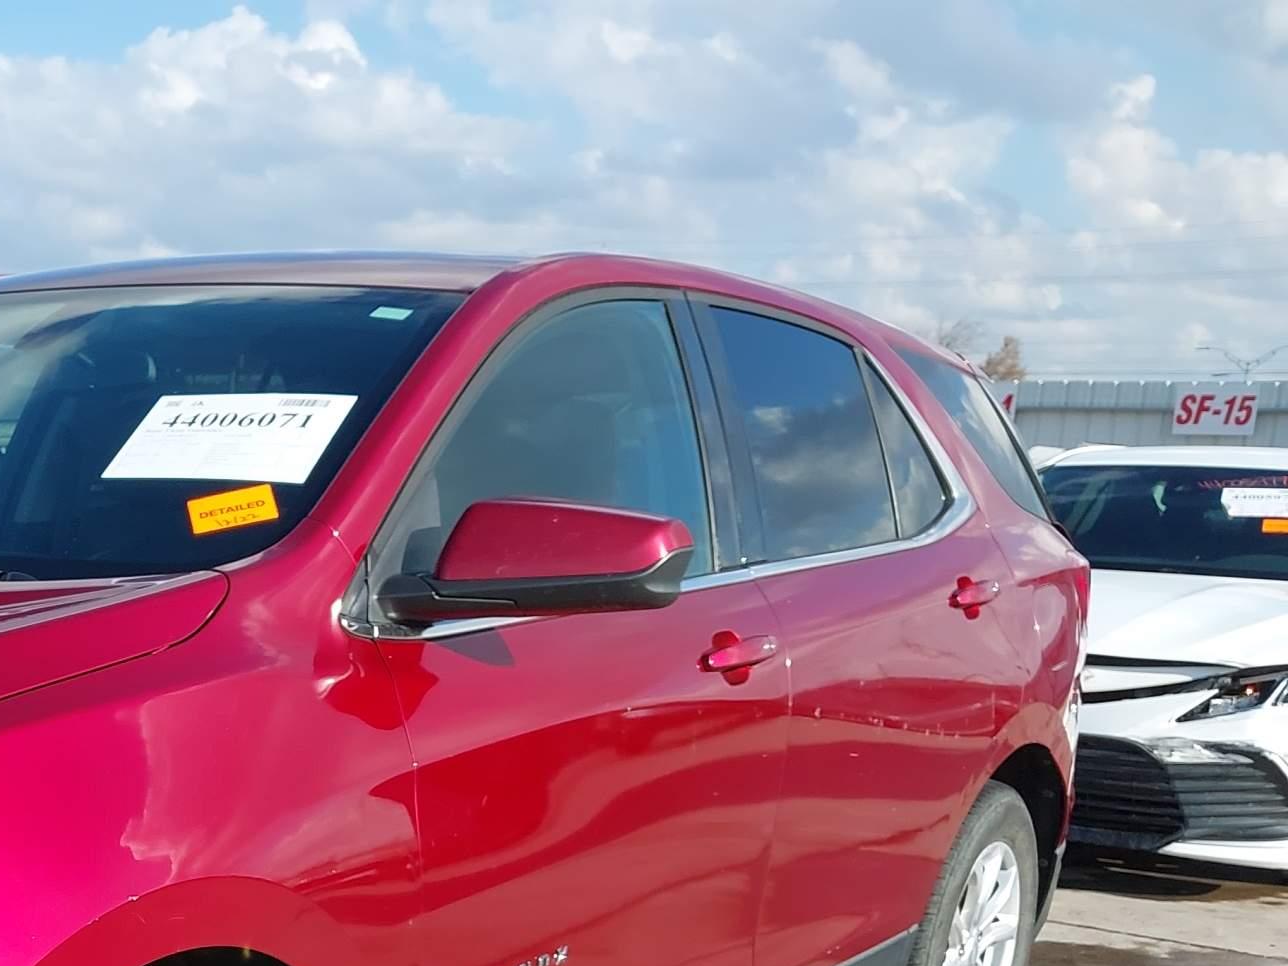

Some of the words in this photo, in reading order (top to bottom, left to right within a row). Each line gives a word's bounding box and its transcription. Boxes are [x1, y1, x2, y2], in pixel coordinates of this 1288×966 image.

[162, 412, 314, 428] 44006071
[1175, 394, 1256, 426] SF-15
[199, 500, 266, 520] DETAILED
